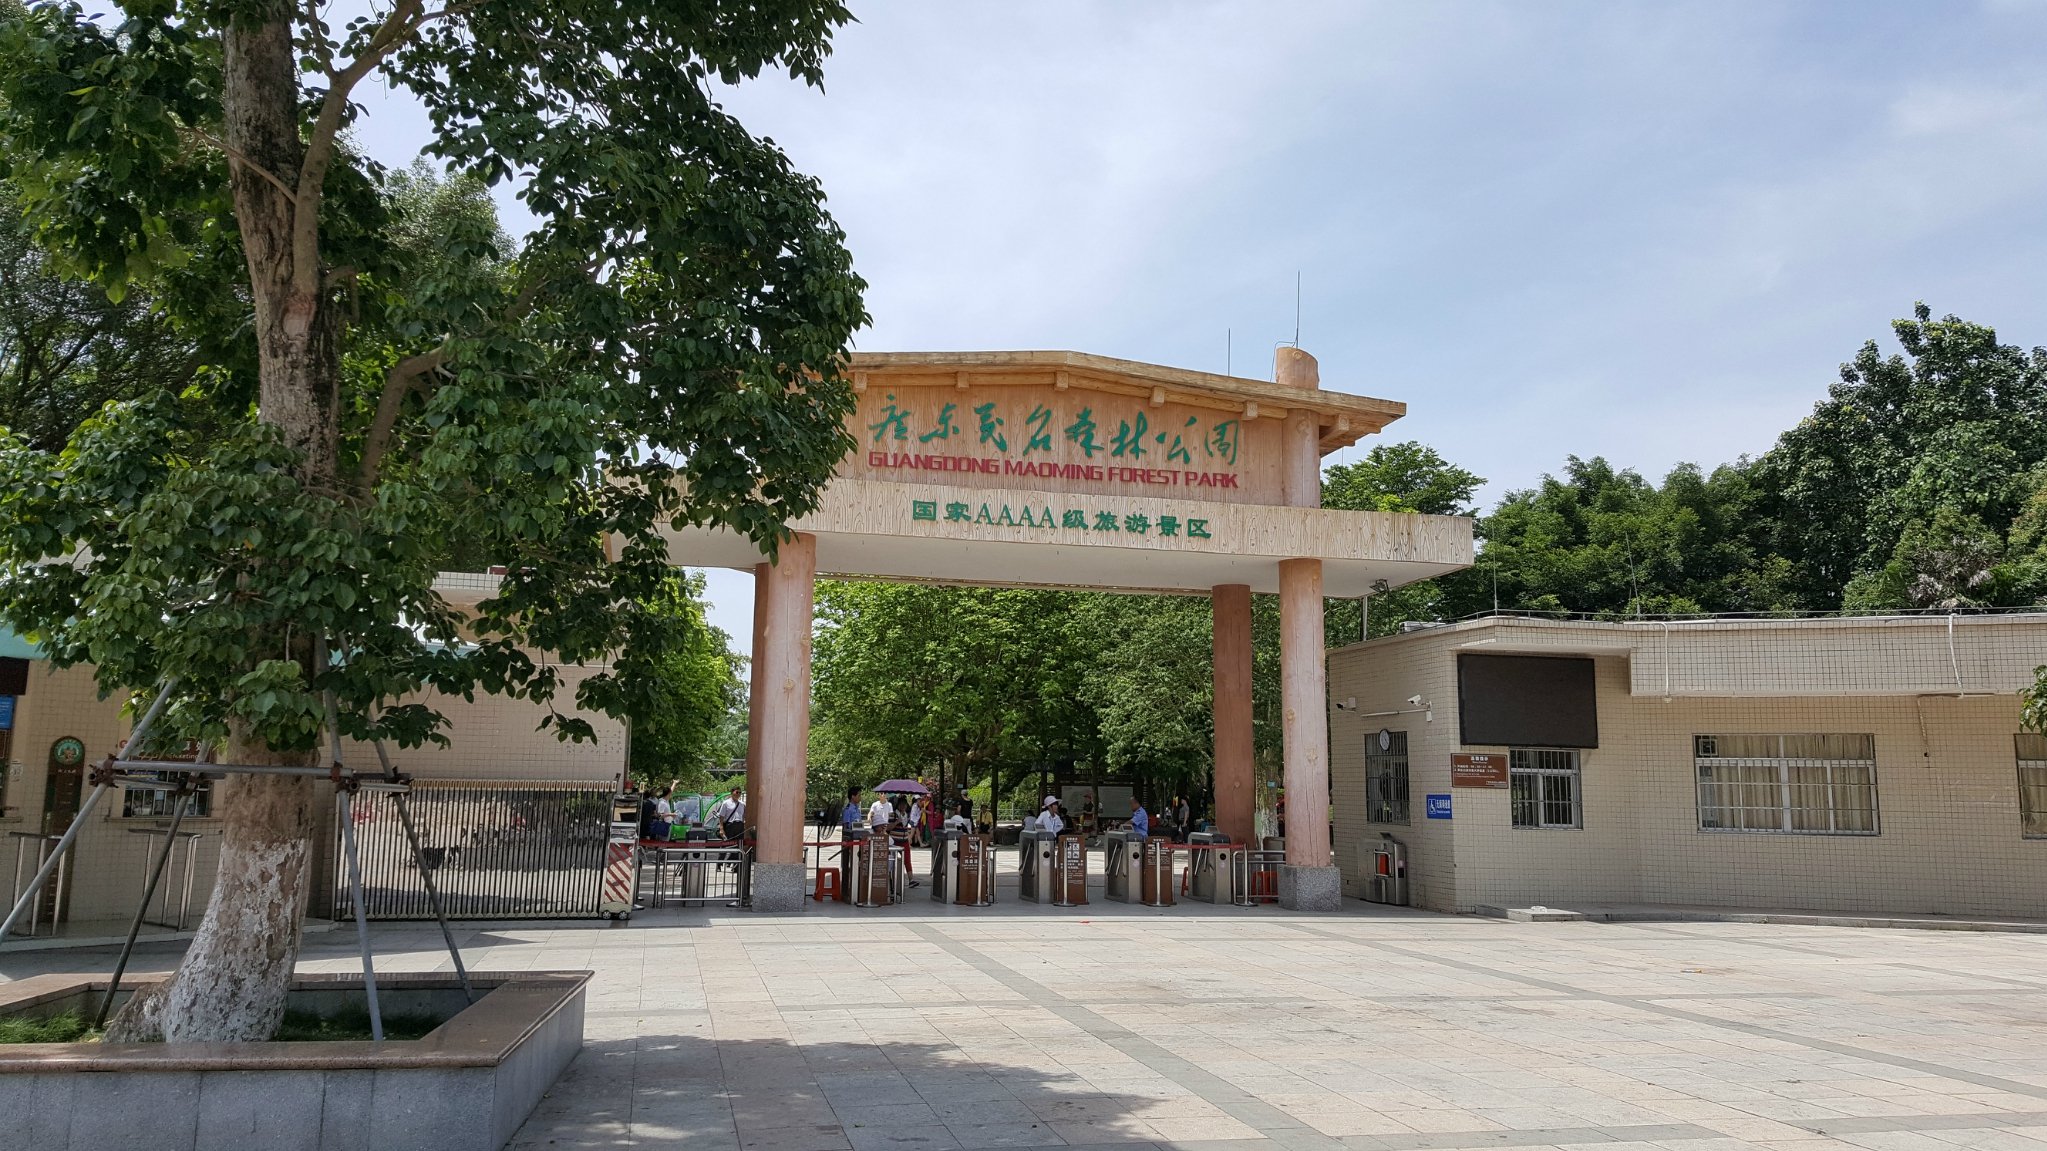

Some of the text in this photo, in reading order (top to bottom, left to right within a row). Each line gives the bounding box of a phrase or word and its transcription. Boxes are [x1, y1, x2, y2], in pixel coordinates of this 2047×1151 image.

[868, 451, 1239, 489] GUANGDONG MAOMING FOREST PARK
[912, 500, 1212, 539] 国家AAAA级旅游景区
